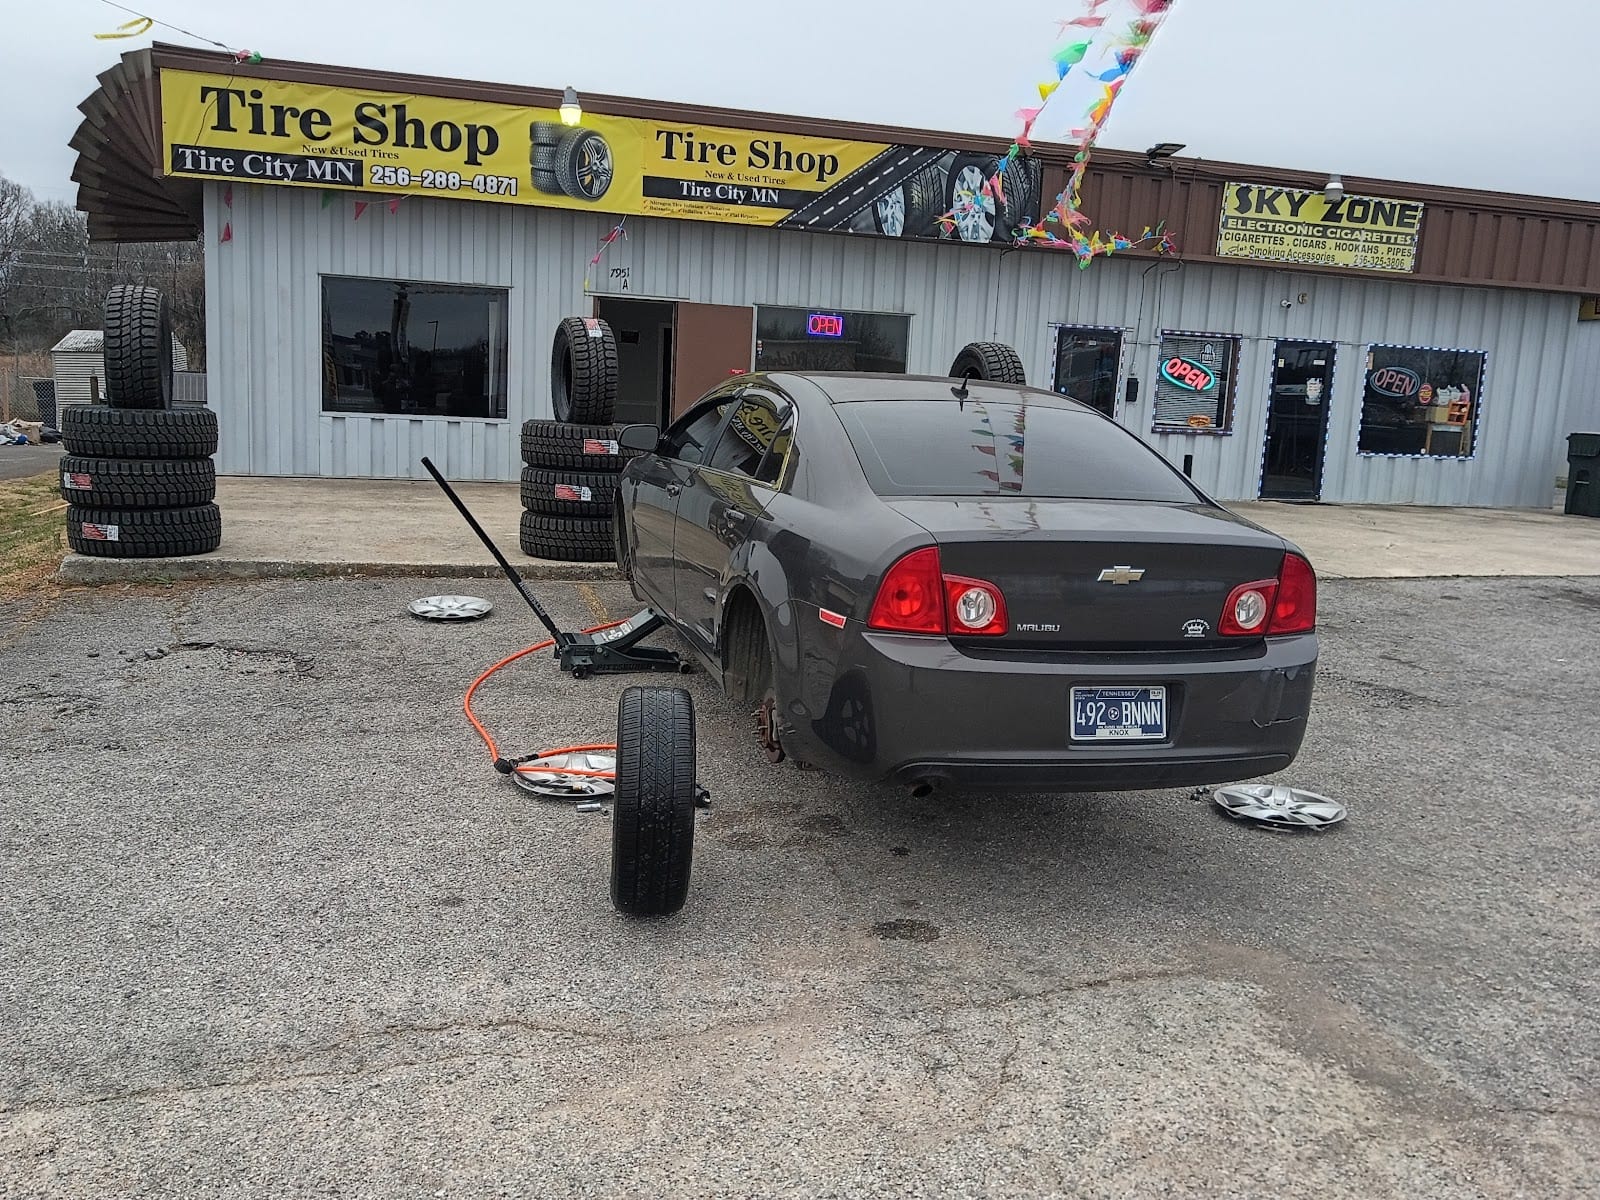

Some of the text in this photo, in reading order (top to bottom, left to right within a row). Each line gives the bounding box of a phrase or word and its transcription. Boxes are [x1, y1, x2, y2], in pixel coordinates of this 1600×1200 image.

[200, 86, 499, 166] Tire Shop
[302, 144, 327, 155] New
[371, 148, 400, 160] Tires
[655, 130, 839, 183] Tire Shop
[178, 148, 355, 183] Tire City MN
[704, 169, 787, 186] New & Used Tires
[370, 165, 519, 196] 256-288-4871
[679, 181, 779, 205] Tire City MN
[1234, 185, 1419, 229] SKY ZONE
[1224, 231, 1412, 257] CIGARETTES CIGARS HOOKAHS PIPES
[1227, 218, 1412, 245] ELECTRONIC CIGARETTES
[1249, 245, 1285, 259] Smoking
[1288, 249, 1336, 262] Accessories
[622, 279, 628, 290] A
[811, 316, 842, 335] OPEN
[1165, 357, 1210, 391] OPEN
[1374, 368, 1415, 396] OPEN
[1017, 623, 1061, 632] MALIBU
[1076, 701, 1161, 726] 492 BNNN
